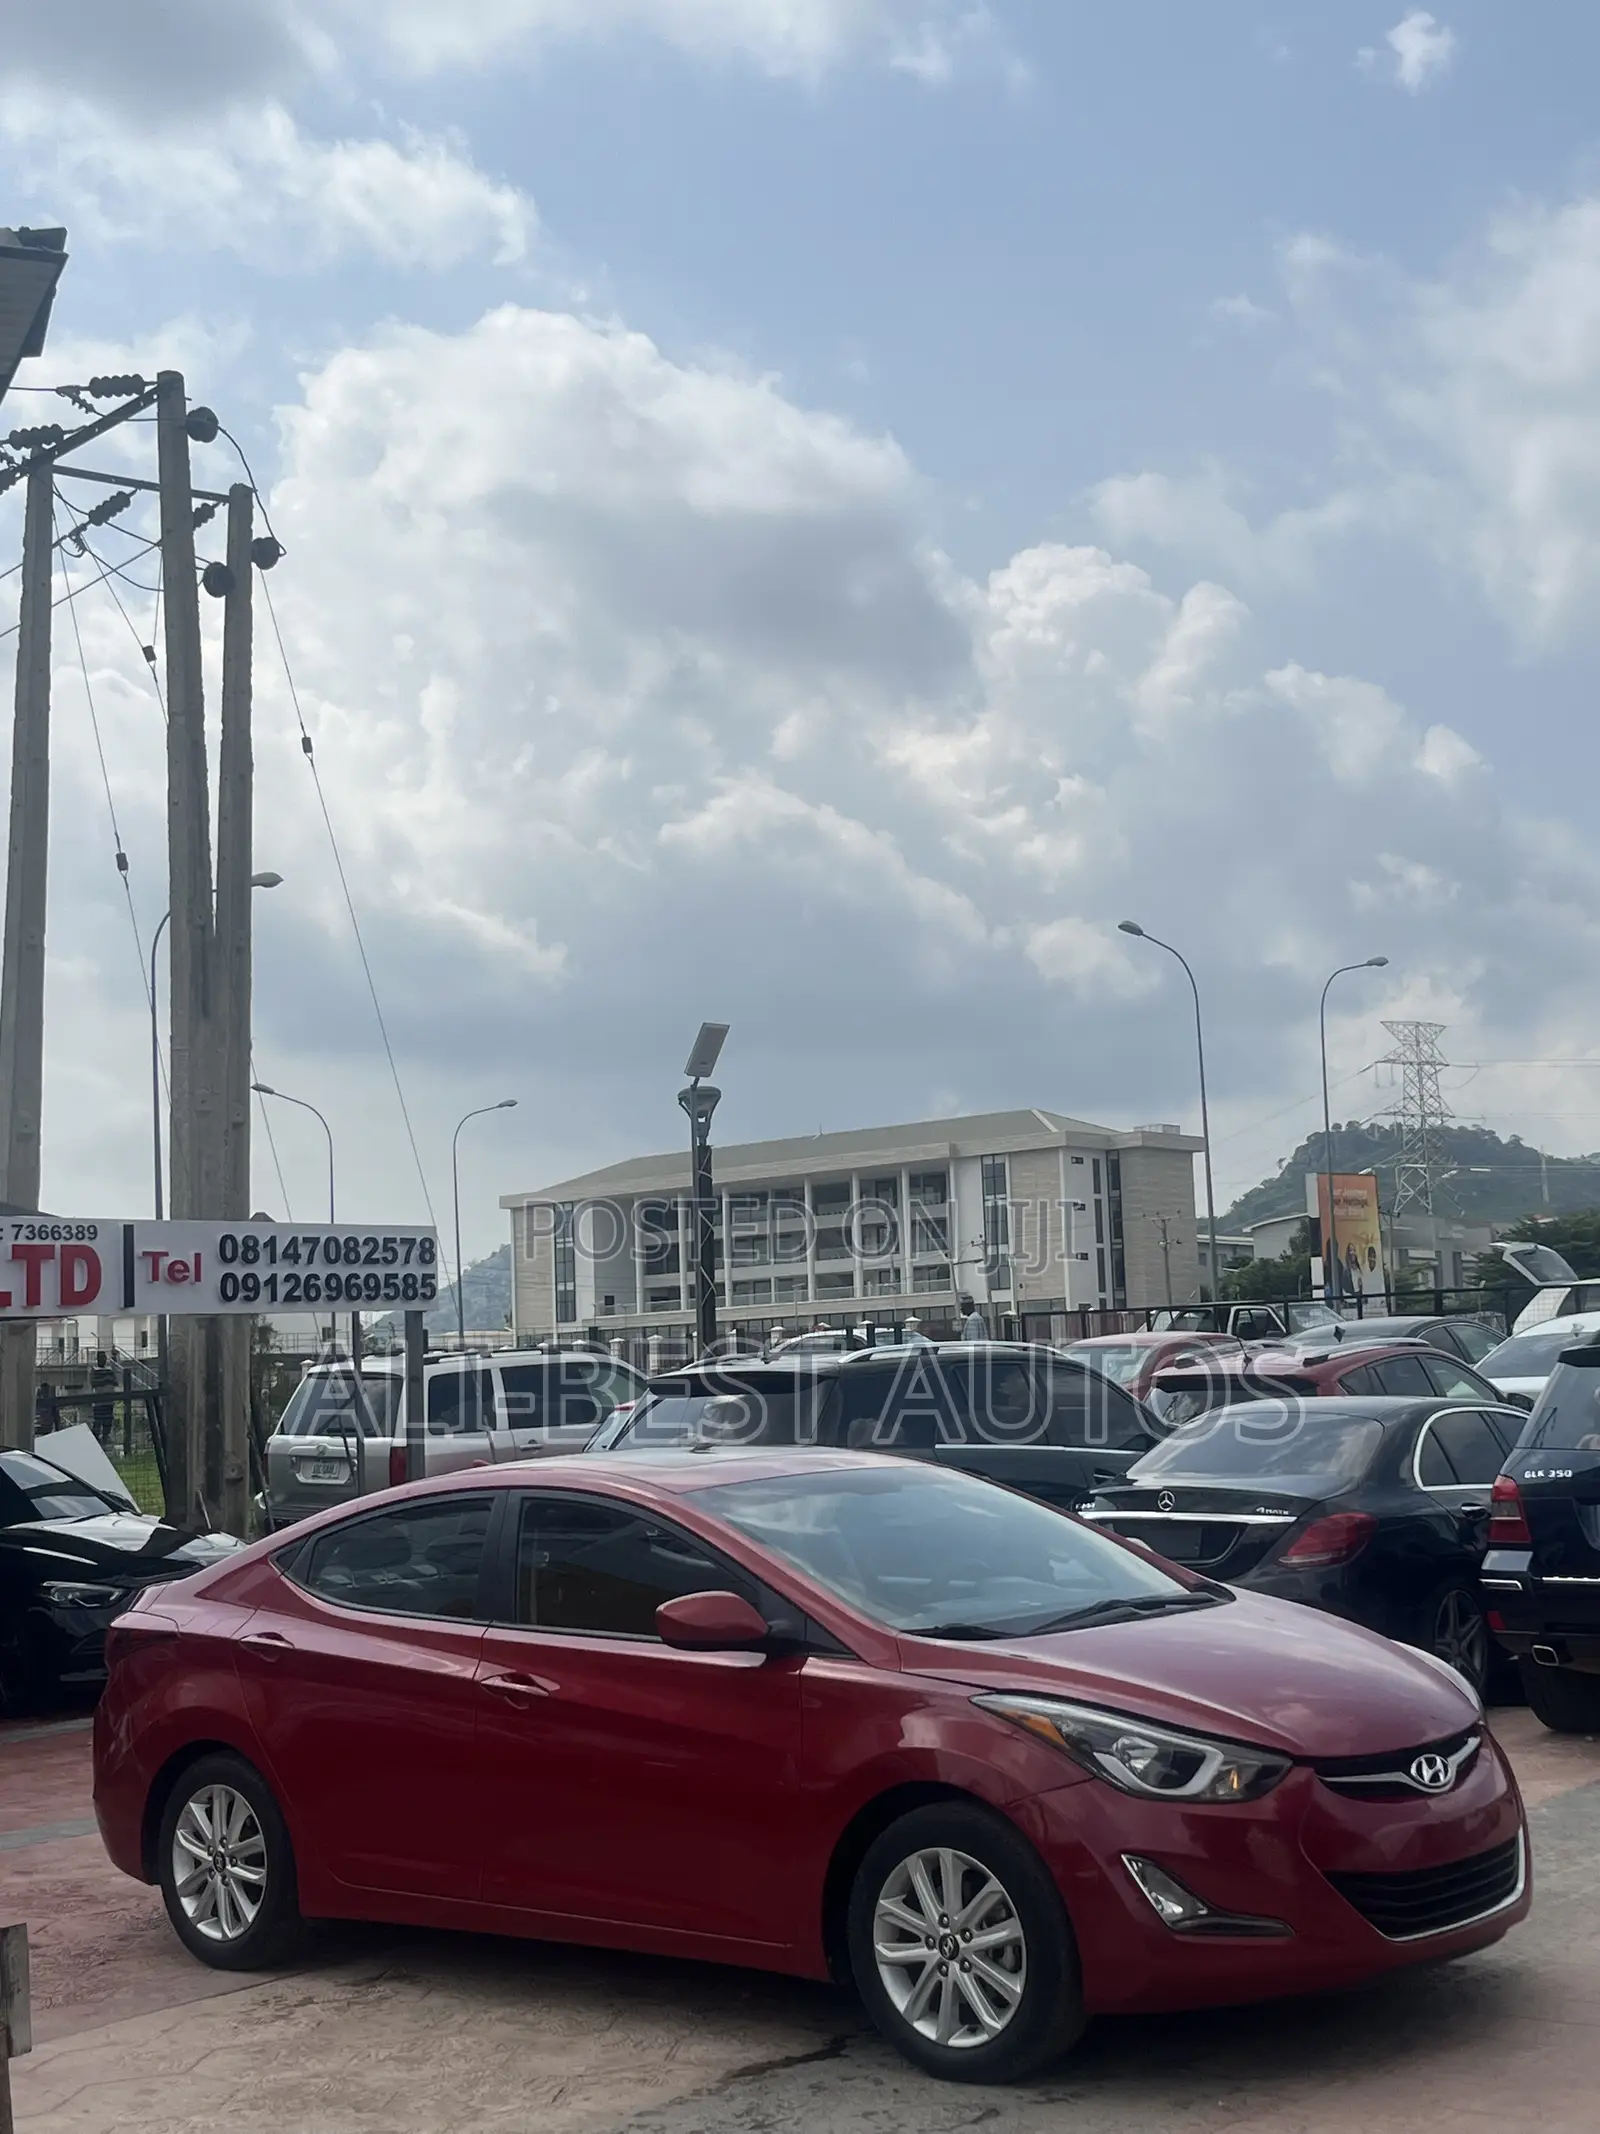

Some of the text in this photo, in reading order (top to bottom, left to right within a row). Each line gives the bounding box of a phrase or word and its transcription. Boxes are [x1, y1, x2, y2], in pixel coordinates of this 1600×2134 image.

[11, 1224, 98, 1241] 7366389
[218, 1233, 436, 1266] 08147082578
[0, 1244, 102, 1307] TD
[141, 1251, 202, 1283] Tel
[219, 1272, 437, 1303] 09126969585
[1524, 1469, 1573, 1479] GLK 350
